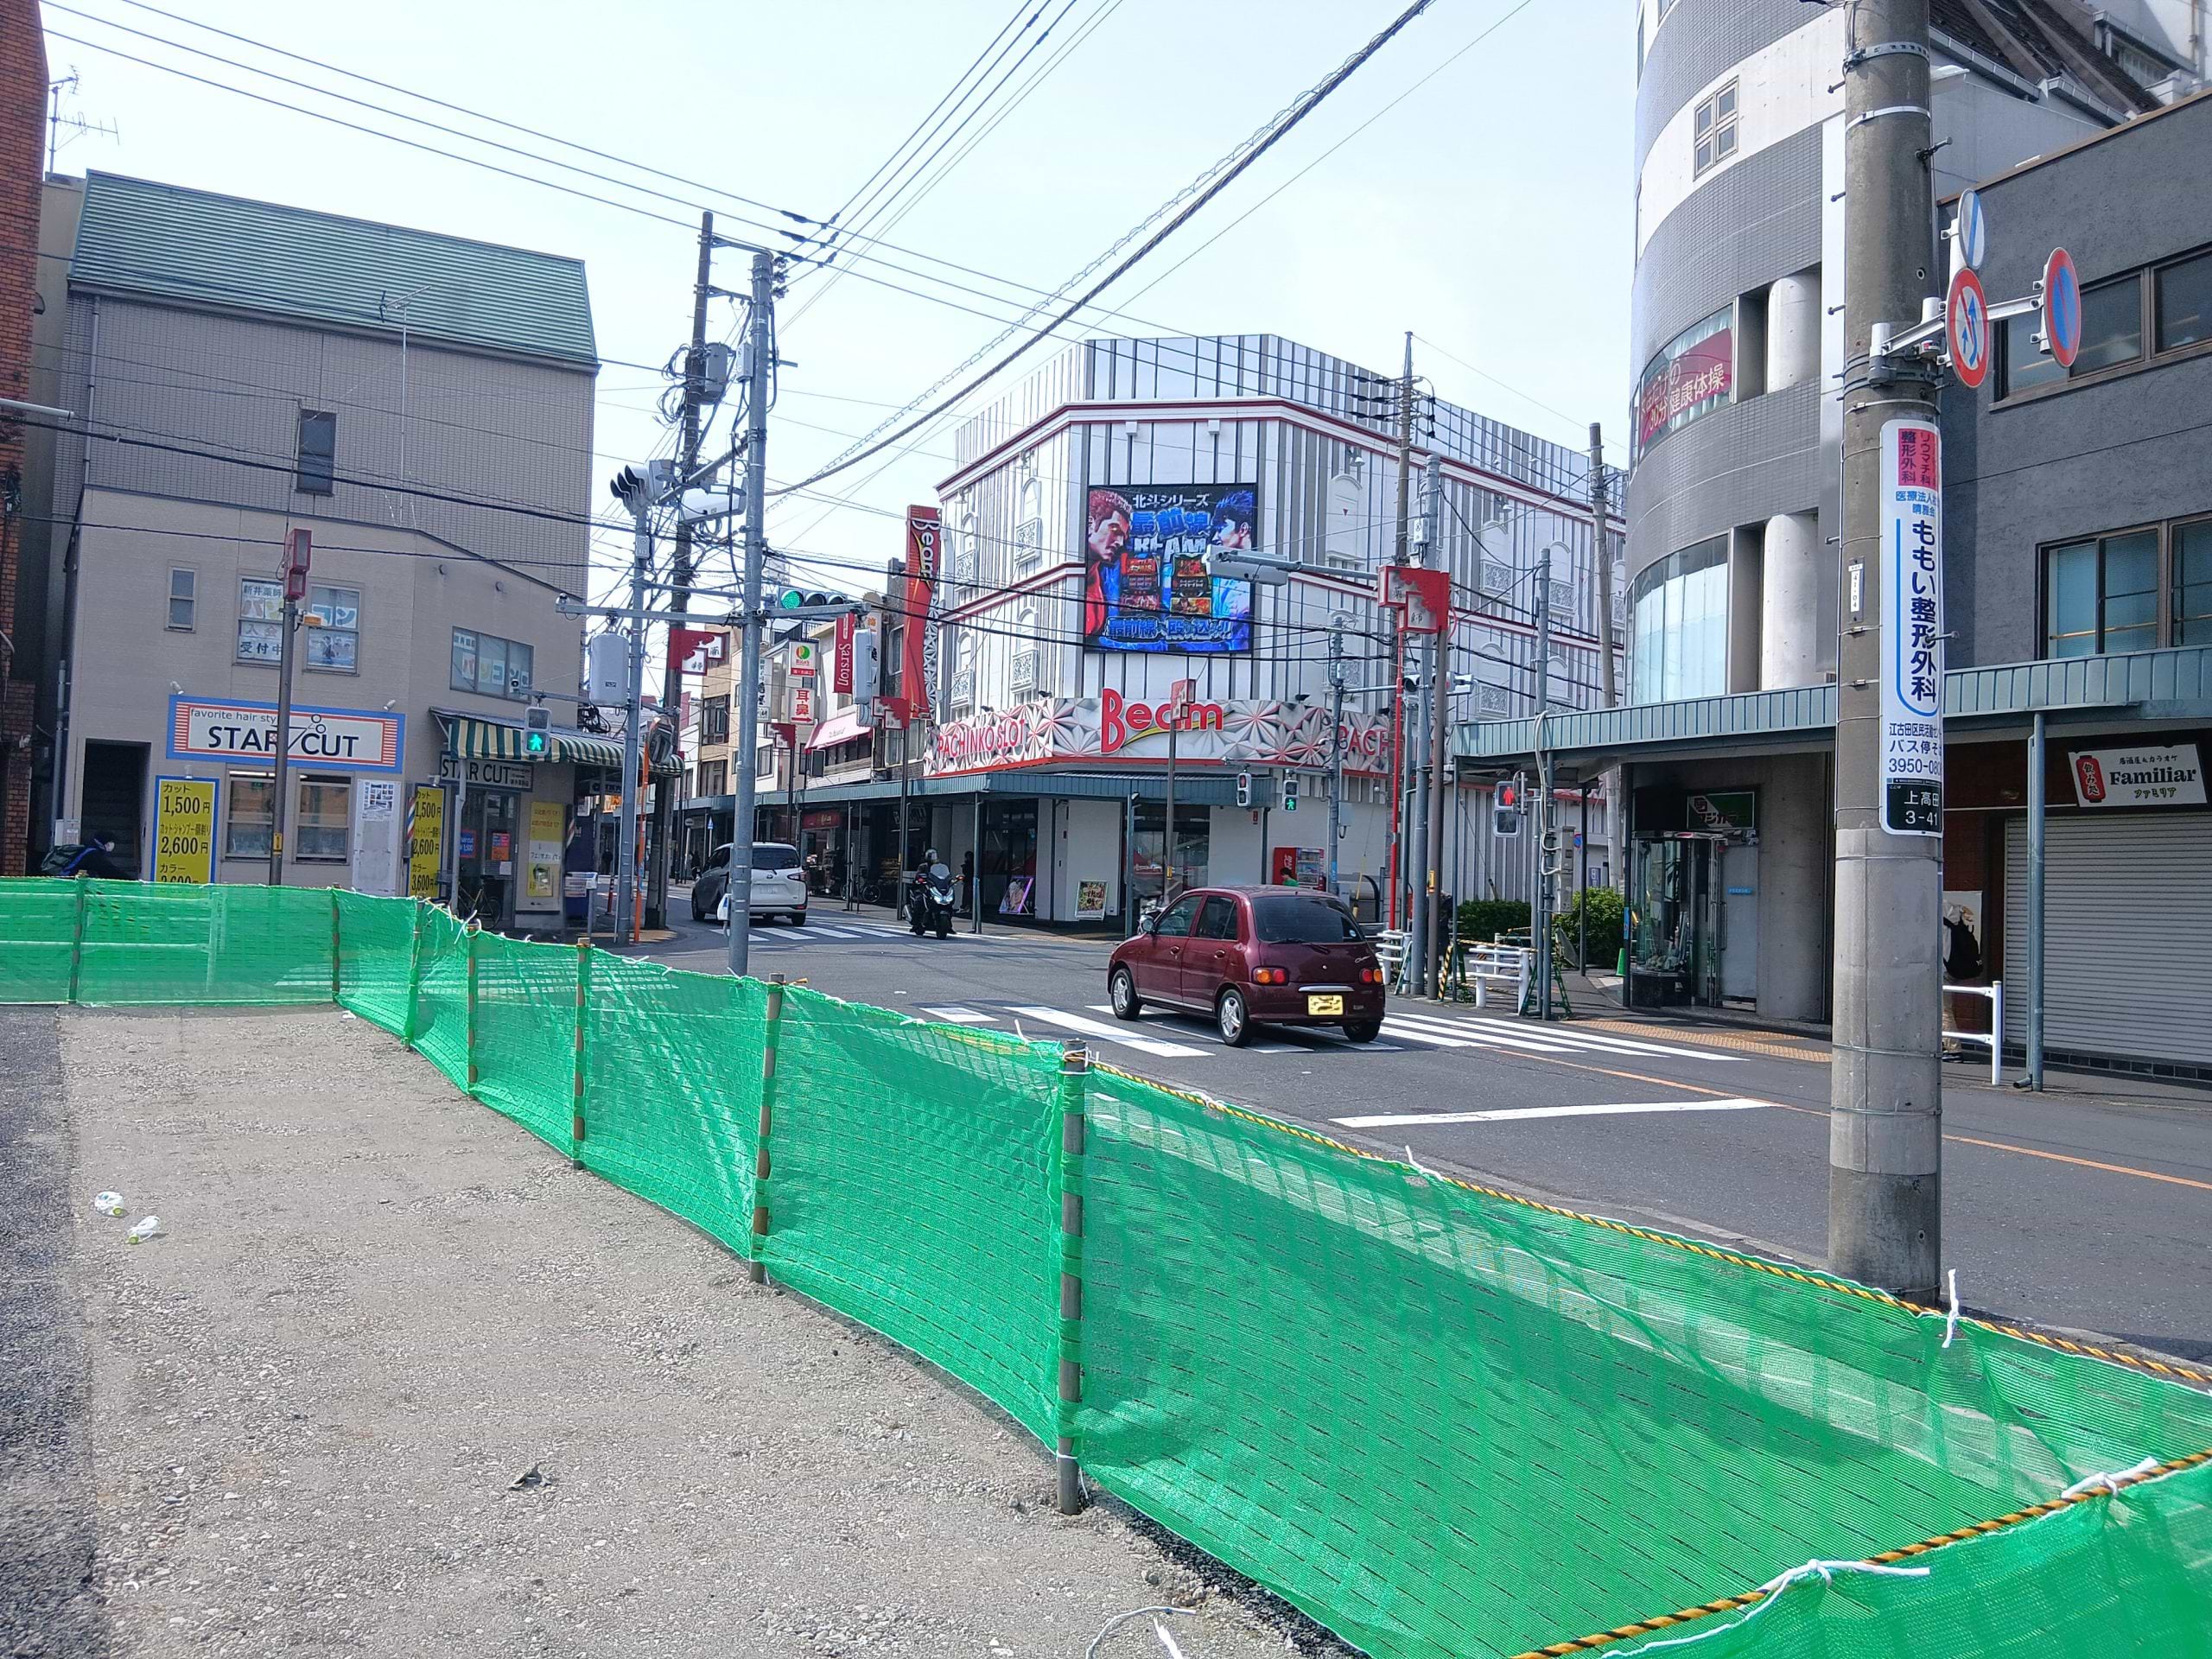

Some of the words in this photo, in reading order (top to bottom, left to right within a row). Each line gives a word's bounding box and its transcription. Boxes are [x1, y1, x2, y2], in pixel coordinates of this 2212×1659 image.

[1901, 431, 1916, 484] 整形外科
[1920, 432, 1931, 486] リウマチ科
[1133, 493, 1210, 509] 北斗シリーズ
[1910, 519, 1936, 703] ももい整形外科
[190, 709, 232, 720] favorite
[236, 711, 257, 722] hair
[260, 713, 277, 724] sty
[1100, 688, 1224, 754] Beam
[301, 734, 359, 758] CUT
[938, 727, 995, 759] PACHINKO
[996, 718, 1026, 750] SLOT
[483, 764, 511, 785] CUT
[2082, 762, 2100, 796] 飲み処
[2109, 766, 2196, 785] Familiar
[163, 783, 191, 793] カット
[2134, 787, 2177, 799] ファミリア
[1904, 791, 1939, 807] 上高田
[1904, 810, 1938, 827] 3-41
[160, 864, 186, 874] カラー
